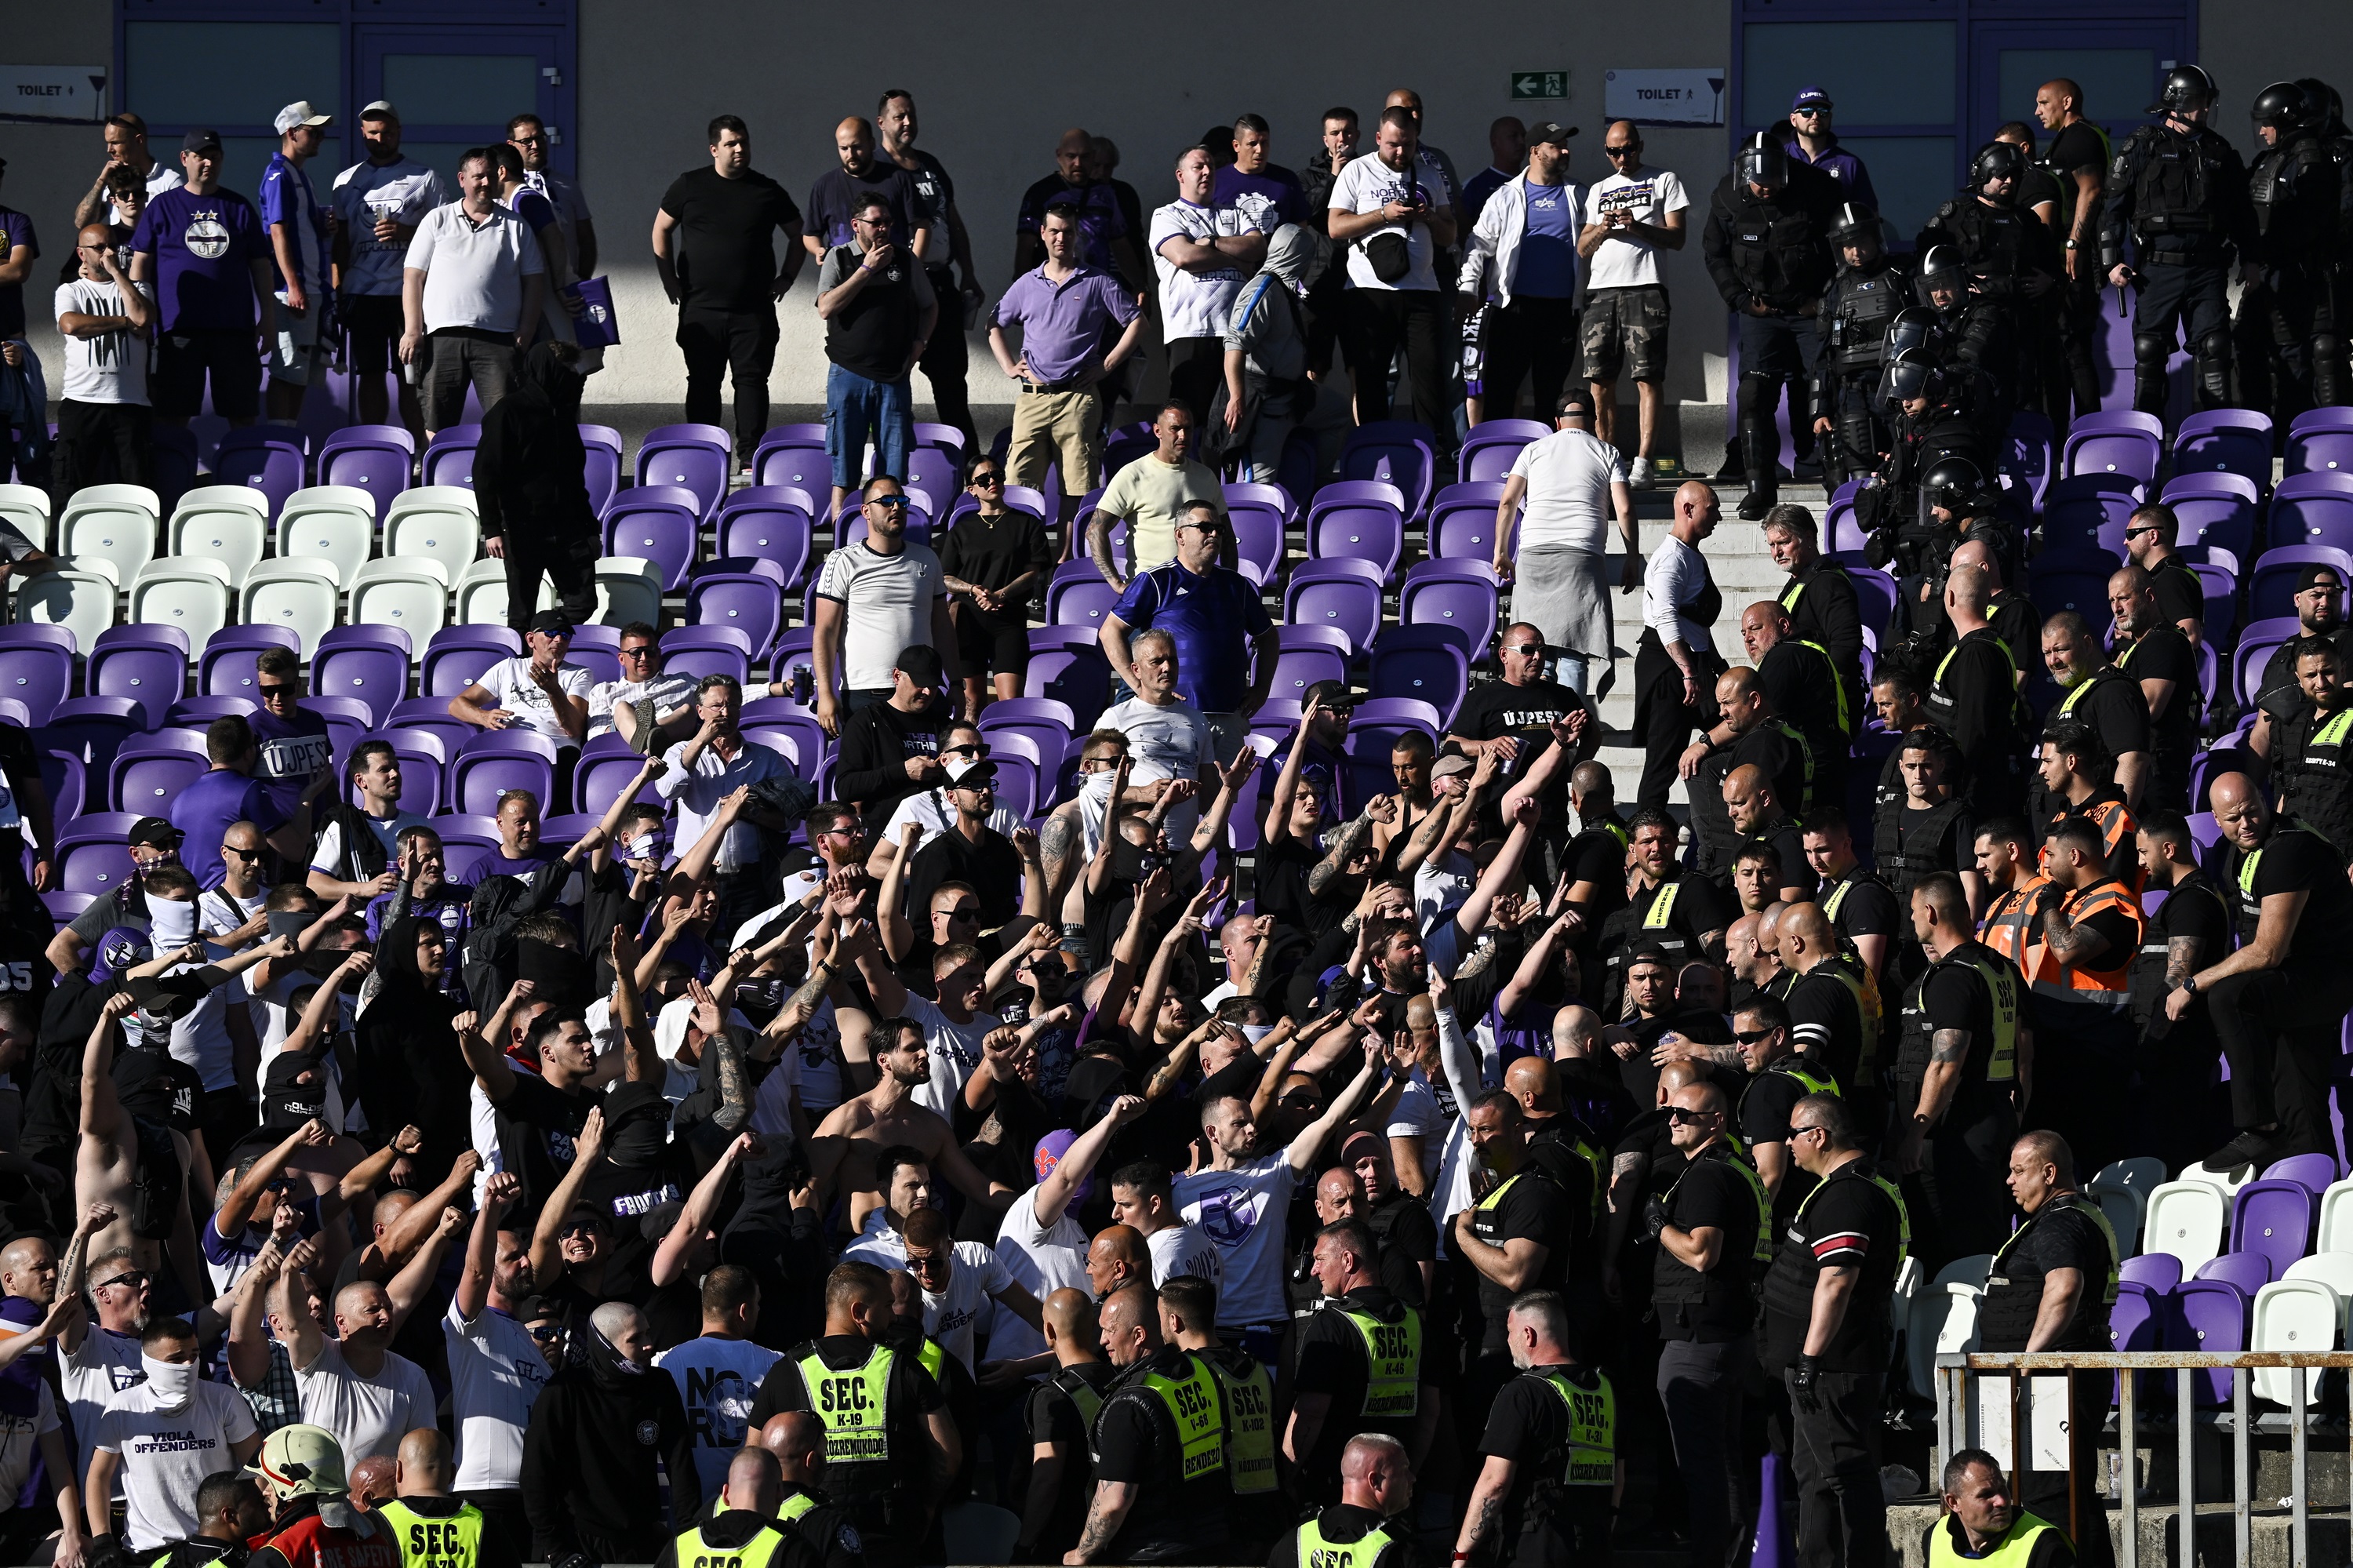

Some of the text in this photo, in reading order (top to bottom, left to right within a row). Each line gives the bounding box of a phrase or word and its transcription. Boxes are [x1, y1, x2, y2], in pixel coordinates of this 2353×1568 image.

[16, 85, 62, 96] TOILET
[1636, 88, 1682, 100] TOILET
[1374, 1326, 1413, 1359] SEC.
[1384, 1362, 1405, 1376] K-46
[820, 1376, 875, 1412] SEC.
[1173, 1381, 1213, 1418] SEC.
[1232, 1384, 1268, 1417] SEC.
[1573, 1392, 1609, 1430] SEC.
[837, 1413, 864, 1427] K-19
[1190, 1413, 1209, 1432] V-68
[1242, 1417, 1265, 1432] K-102
[151, 1429, 196, 1442] VIOLA
[1585, 1430, 1603, 1445] K-31
[134, 1438, 216, 1453] OFFENDERS
[409, 1523, 466, 1556] SEC.
[347, 1543, 392, 1568] SAFETY
